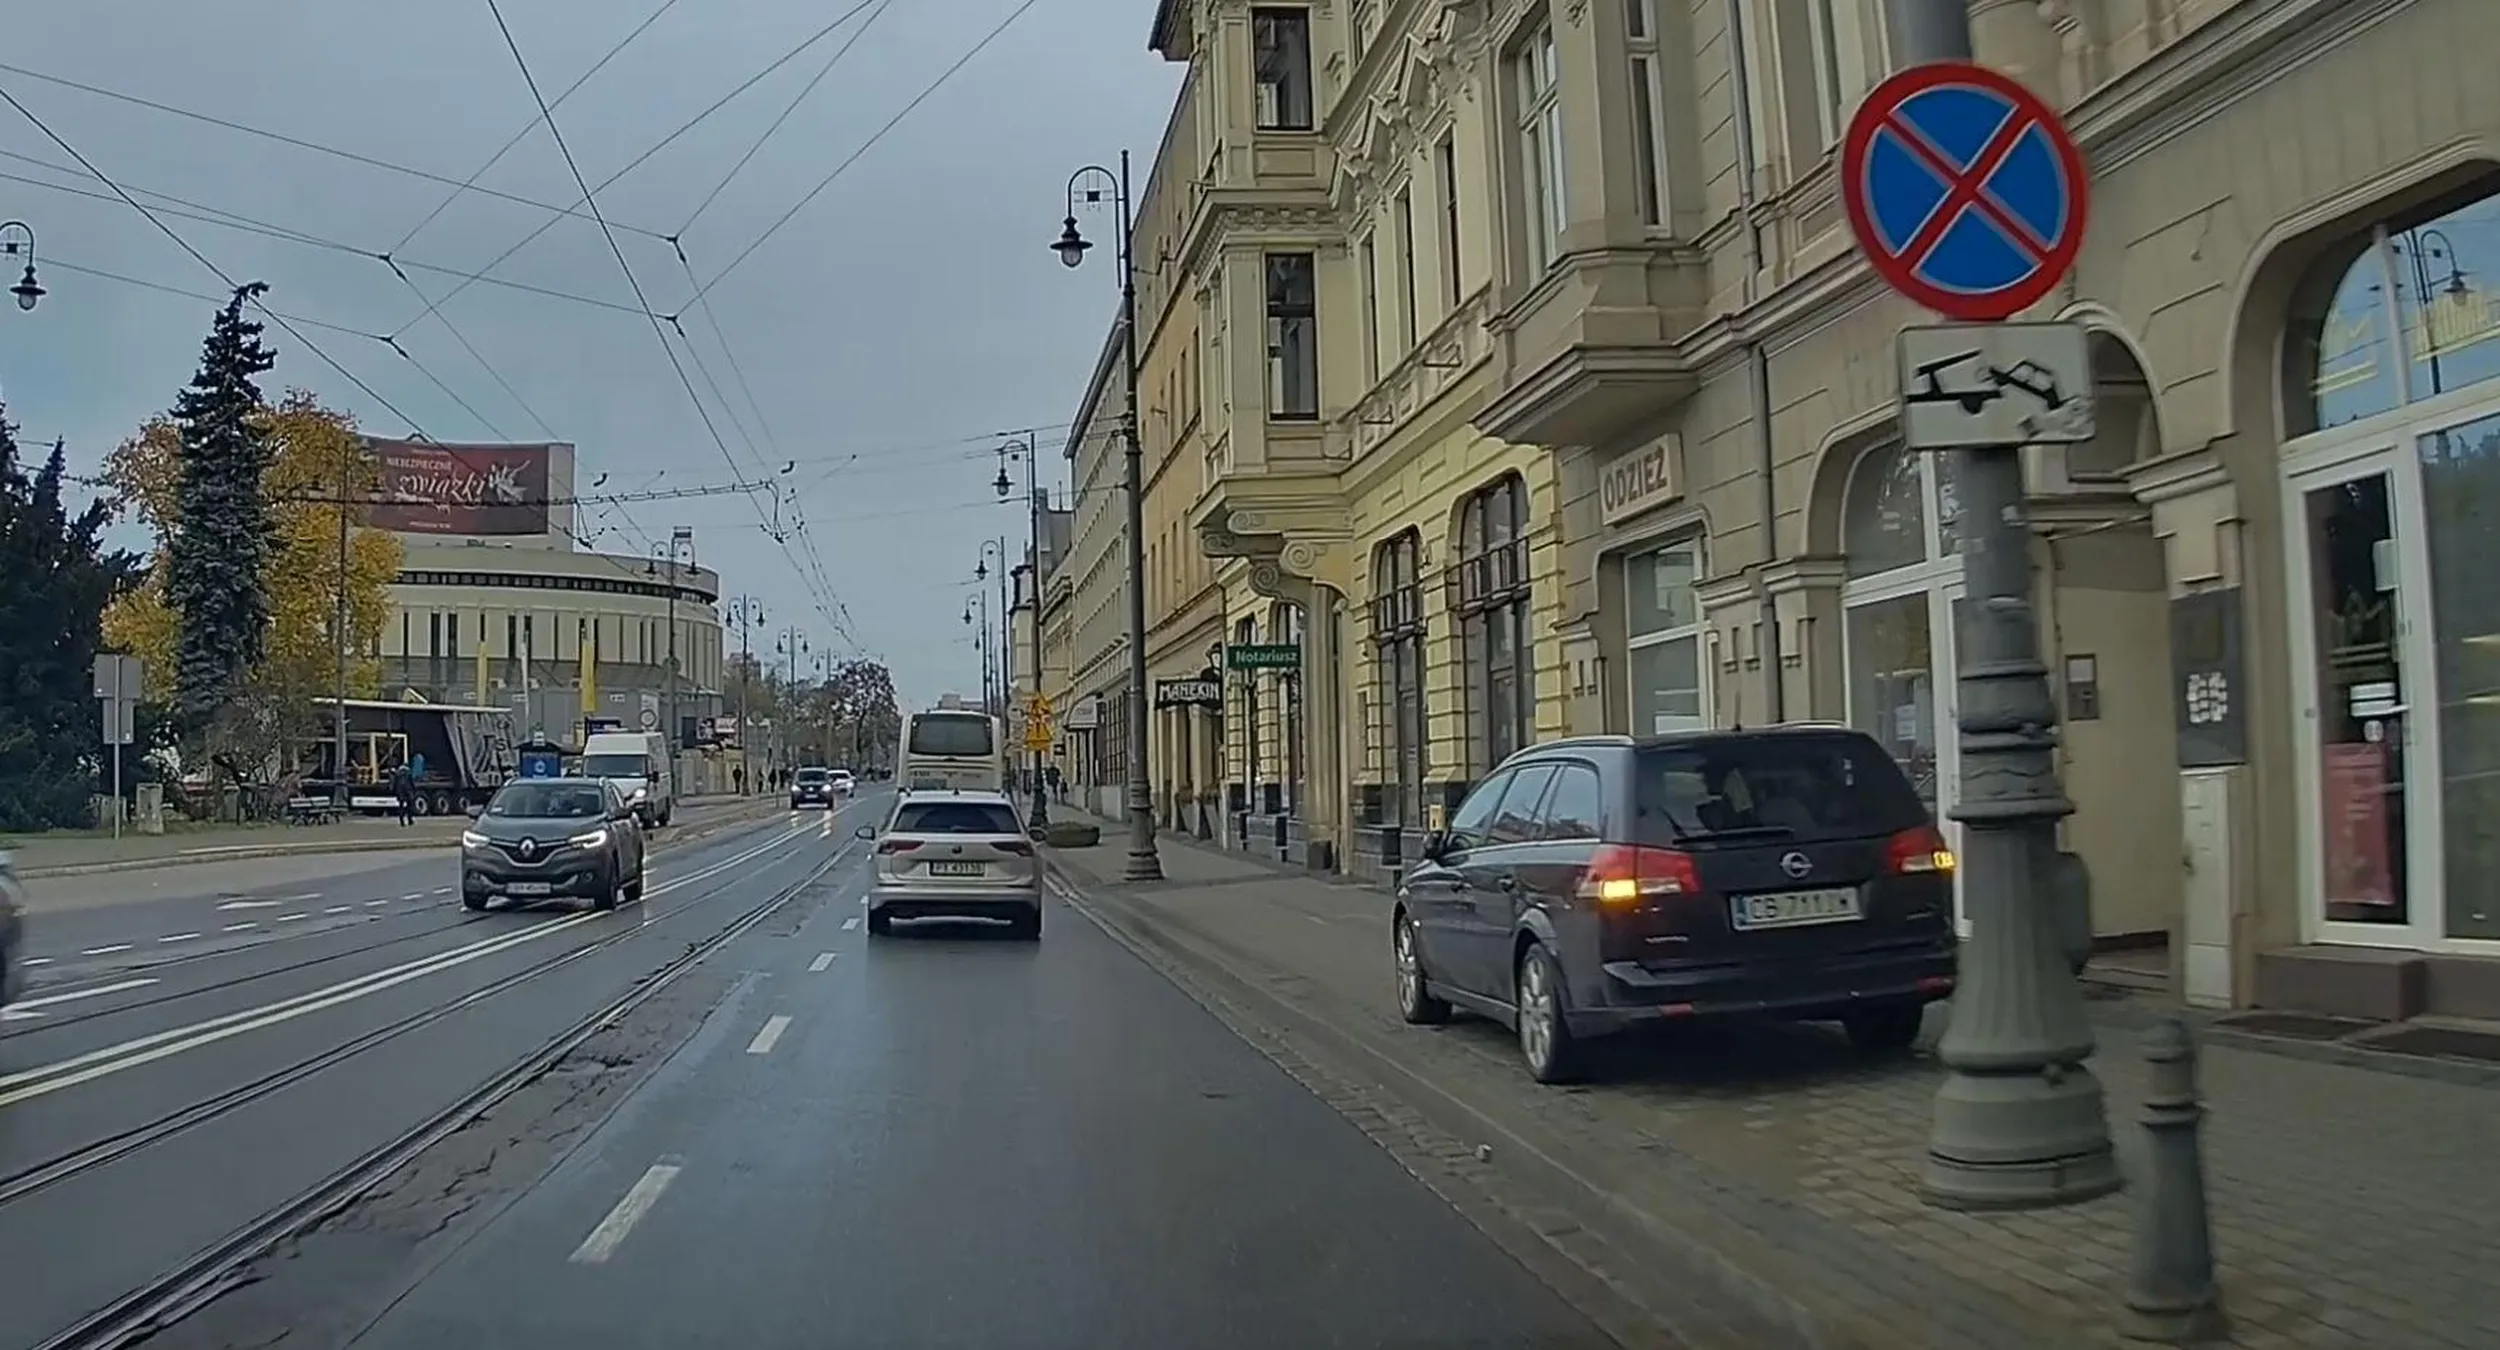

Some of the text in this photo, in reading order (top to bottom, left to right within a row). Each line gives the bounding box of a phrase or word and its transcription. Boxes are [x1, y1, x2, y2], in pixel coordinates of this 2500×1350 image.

[1604, 445, 1668, 512] ODZIEŻ
[1235, 650, 1298, 663] Notariusz
[1159, 682, 1220, 701] MANEKIN
